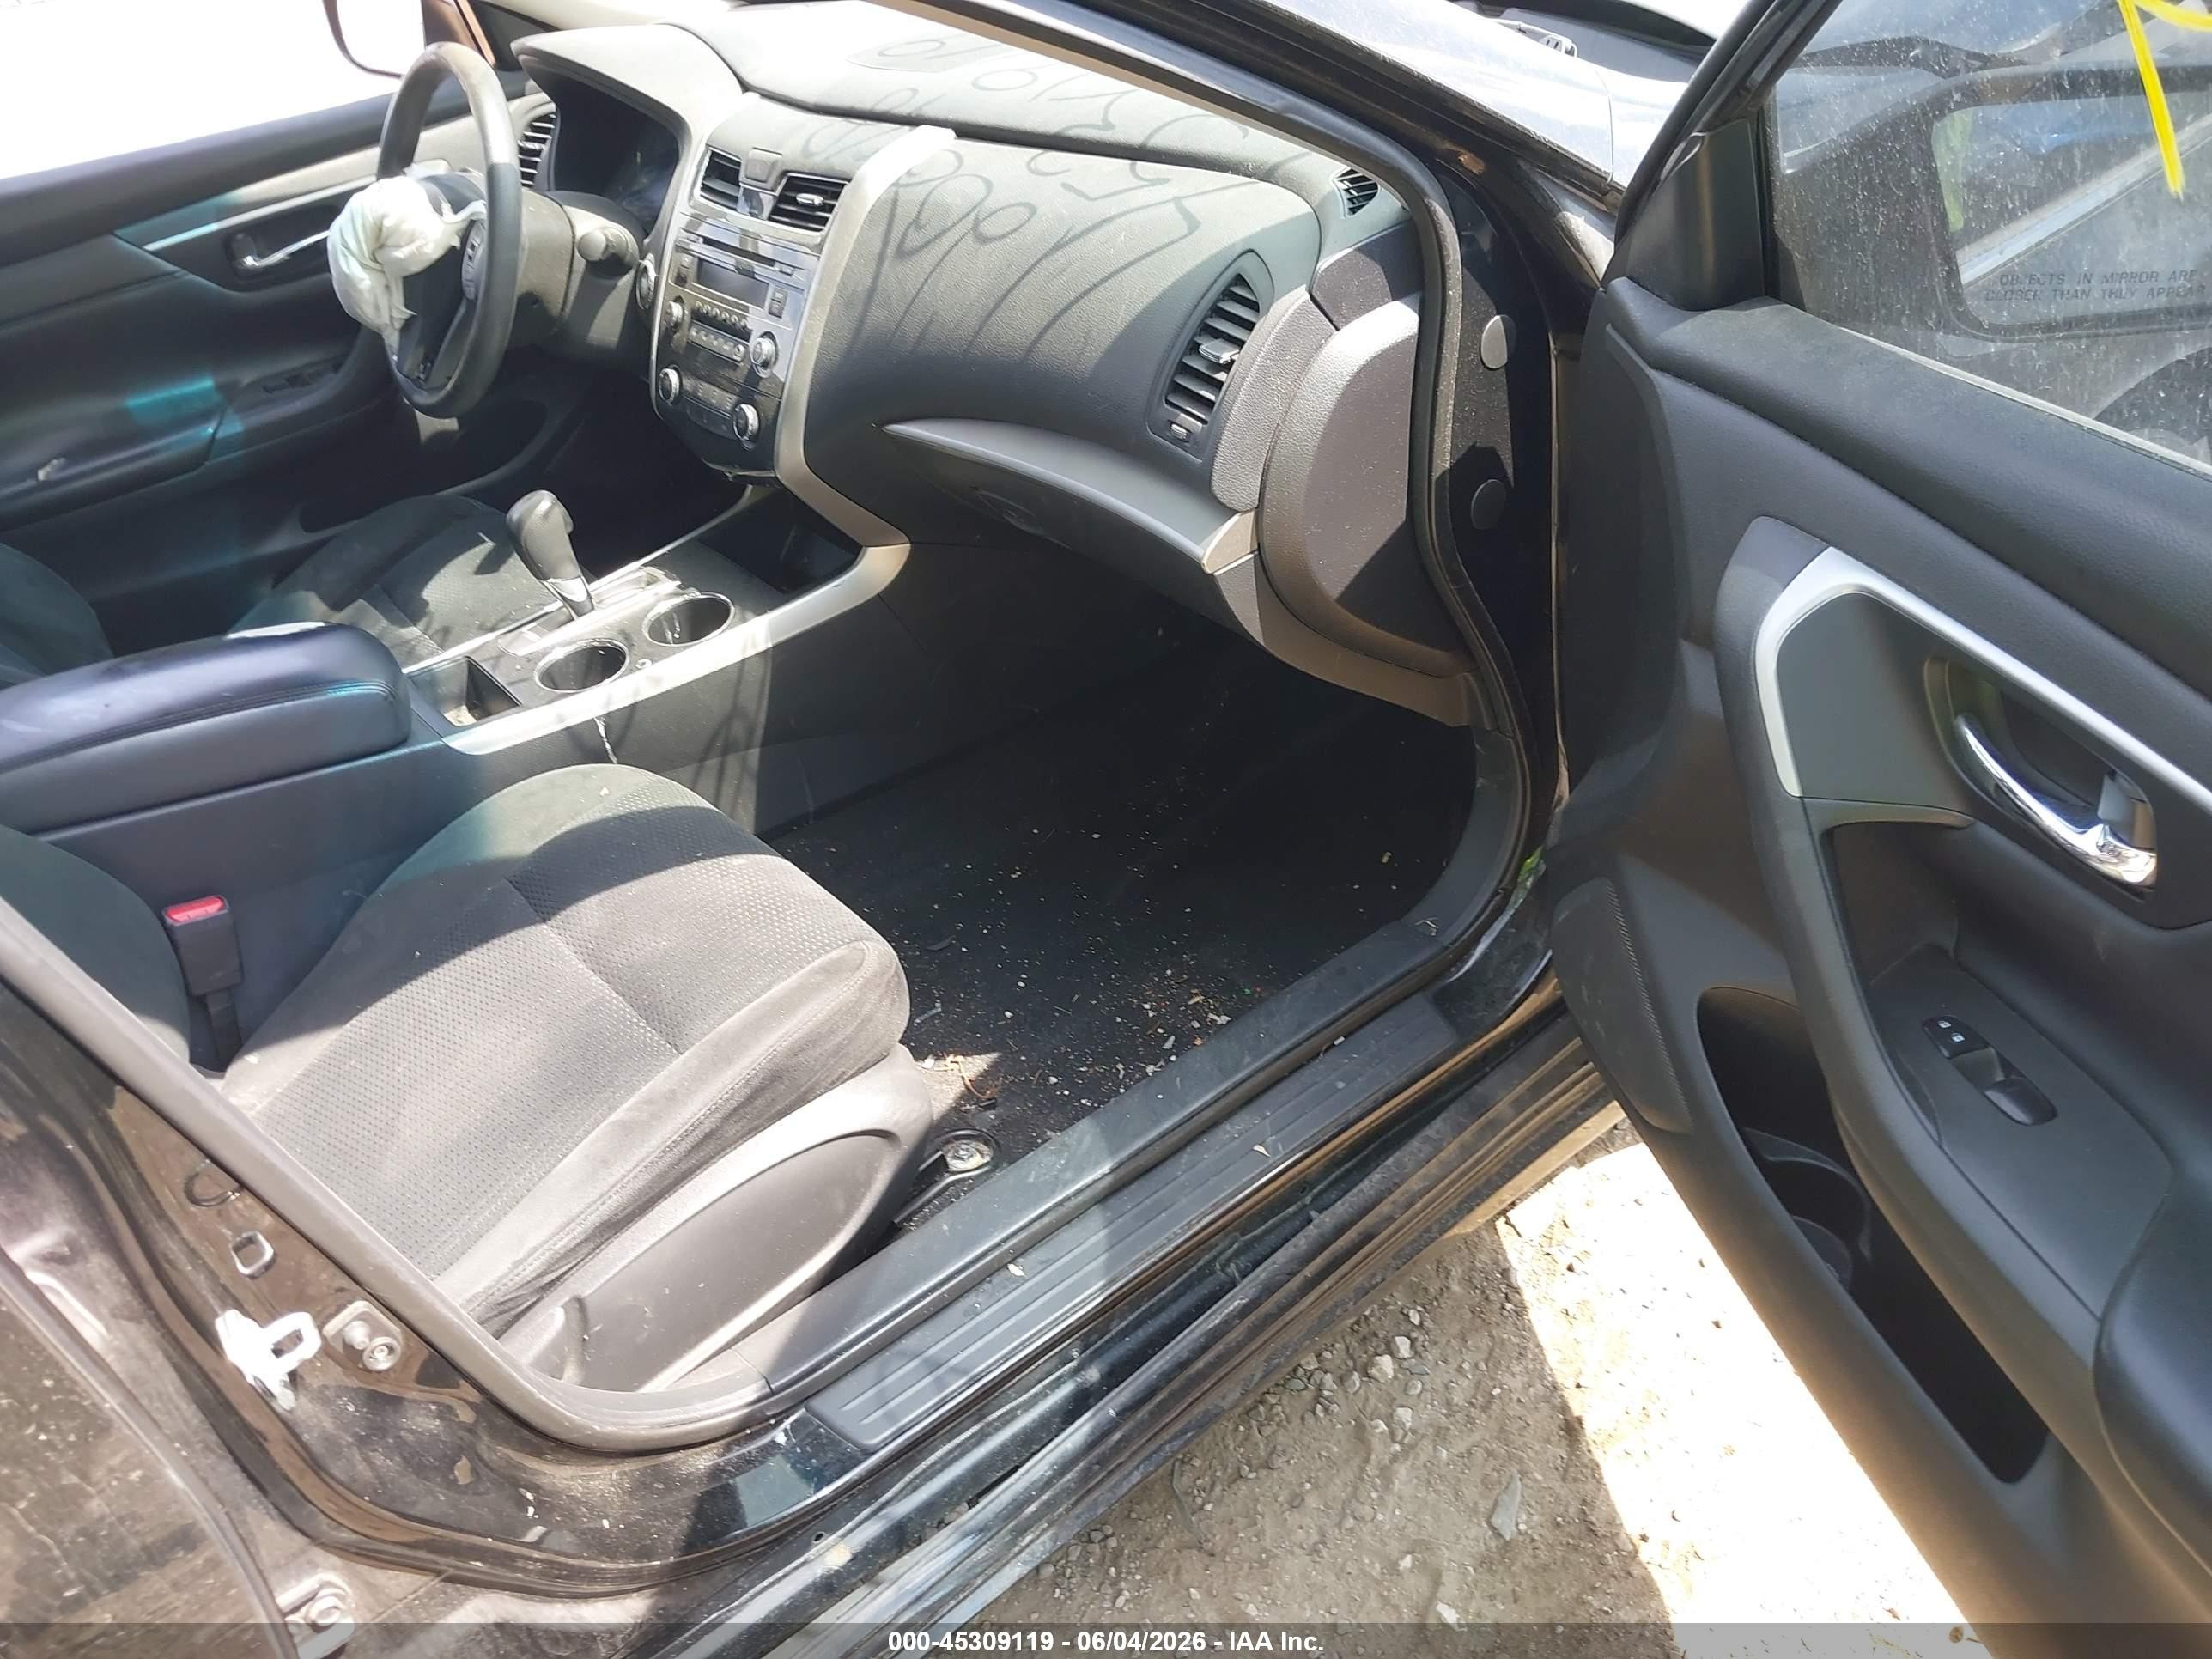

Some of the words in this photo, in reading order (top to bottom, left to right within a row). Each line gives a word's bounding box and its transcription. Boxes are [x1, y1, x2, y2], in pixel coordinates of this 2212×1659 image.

[2000, 274, 2066, 286] OBECTS
[2077, 273, 2094, 285] IN
[2168, 269, 2198, 283] ARE
[2052, 288, 2092, 301] THAN
[2100, 287, 2138, 300] THEY
[2146, 284, 2207, 300] APPEAR
